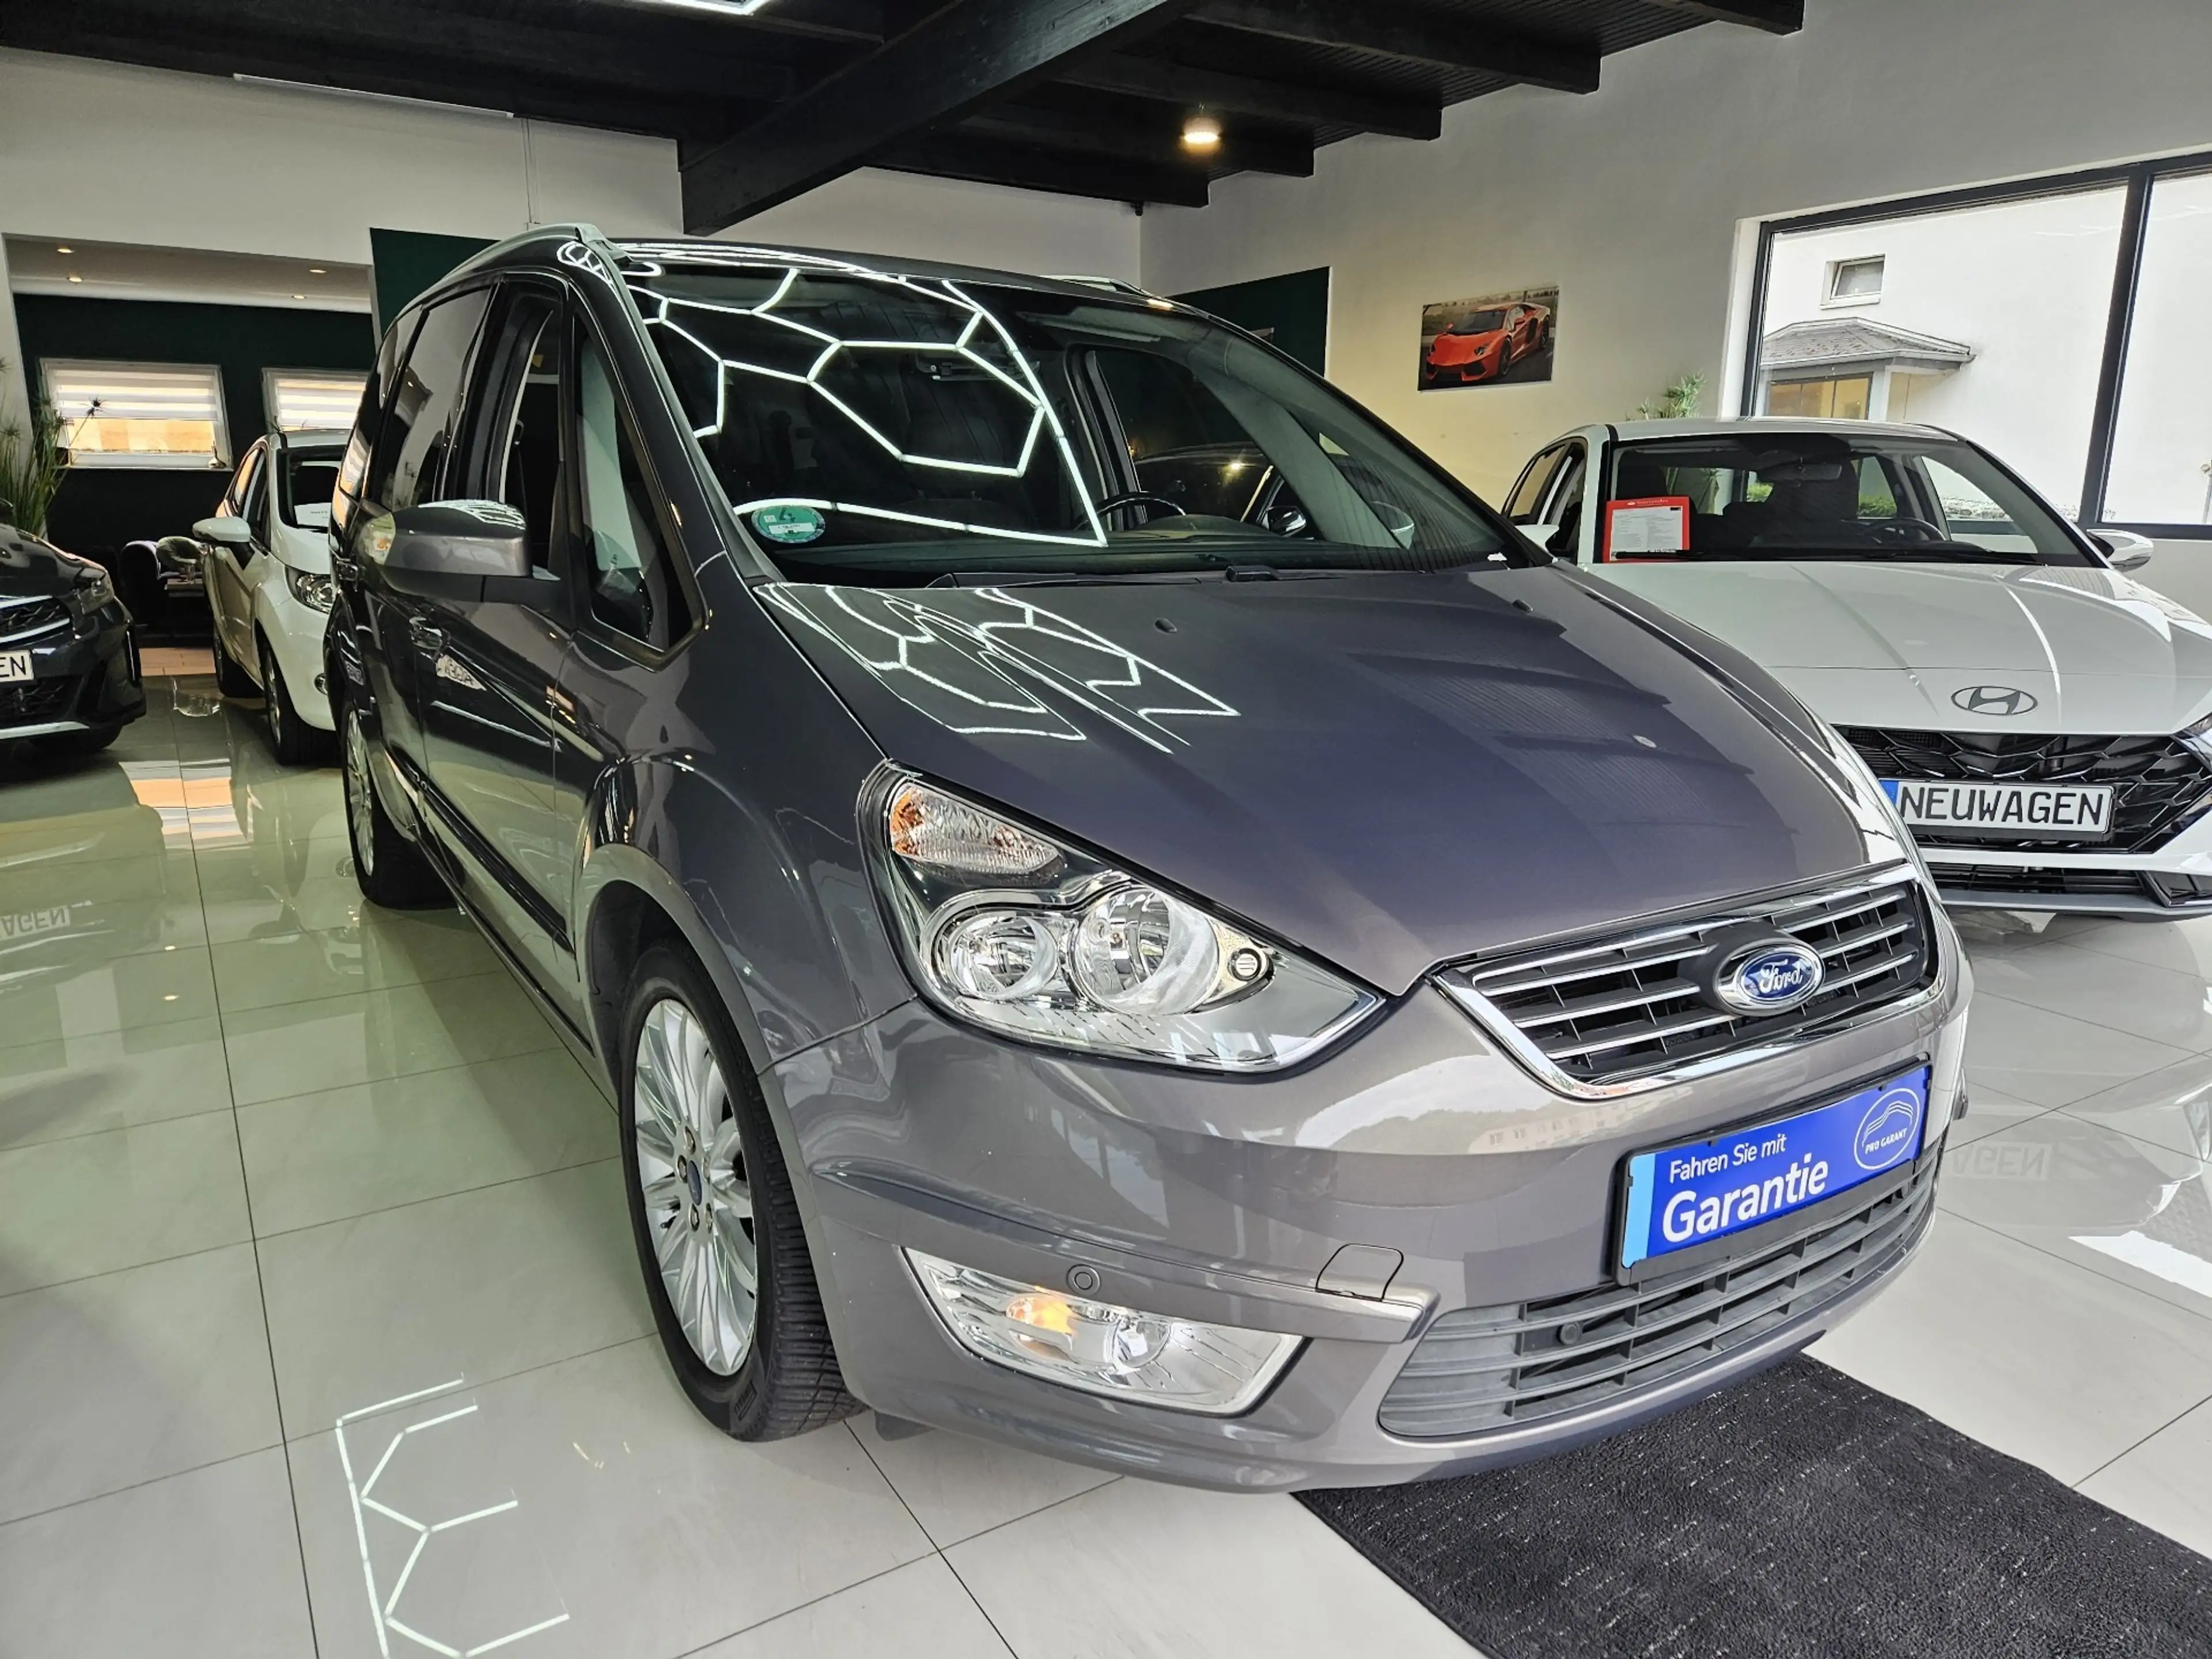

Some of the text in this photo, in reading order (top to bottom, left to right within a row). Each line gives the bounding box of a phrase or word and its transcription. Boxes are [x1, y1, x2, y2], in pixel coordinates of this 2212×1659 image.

[1902, 786, 2104, 825] NEUWAGEN
[1760, 959, 1804, 994] Ford
[1669, 1134, 1787, 1184] Fahren Sie mit
[1662, 1153, 1829, 1243] Garantie
